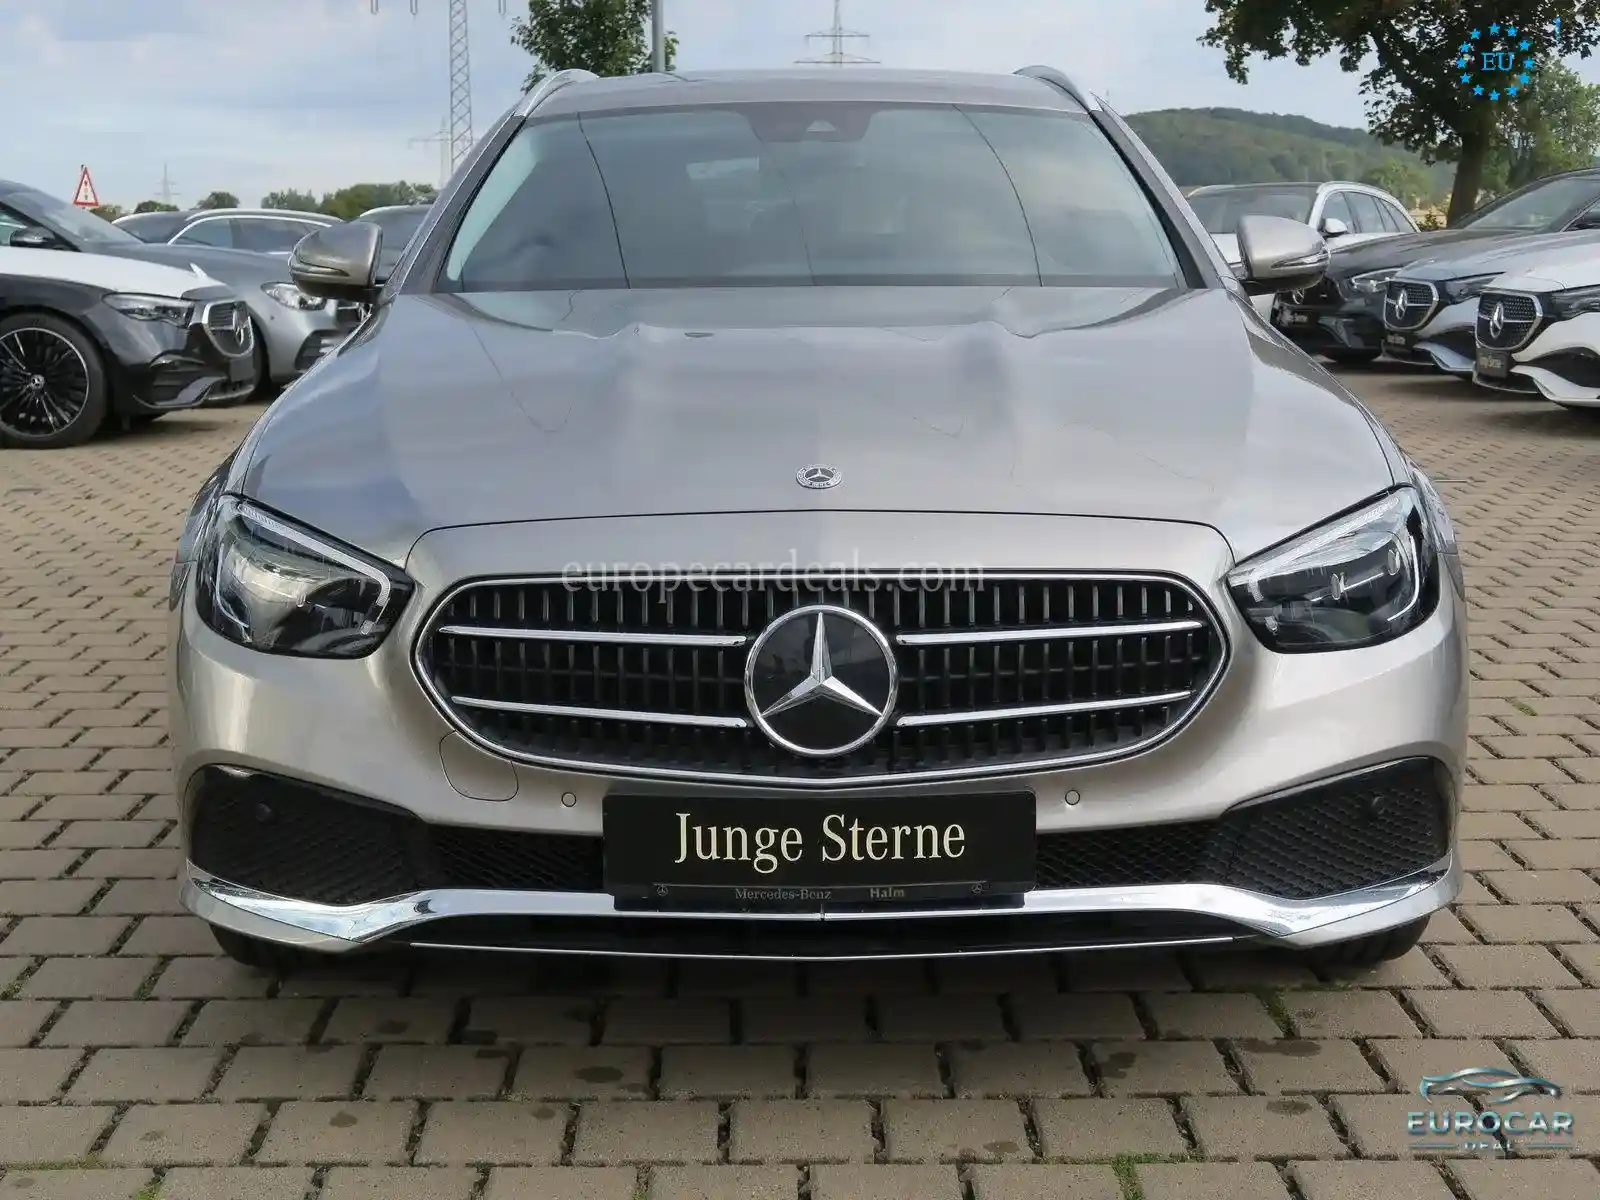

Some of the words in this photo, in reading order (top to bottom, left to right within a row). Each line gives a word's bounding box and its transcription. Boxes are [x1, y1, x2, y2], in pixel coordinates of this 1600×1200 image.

[674, 812, 803, 874] Junge
[821, 813, 966, 862] Sterne
[734, 888, 832, 901] Mercedes-Benz
[869, 886, 906, 899] Halm
